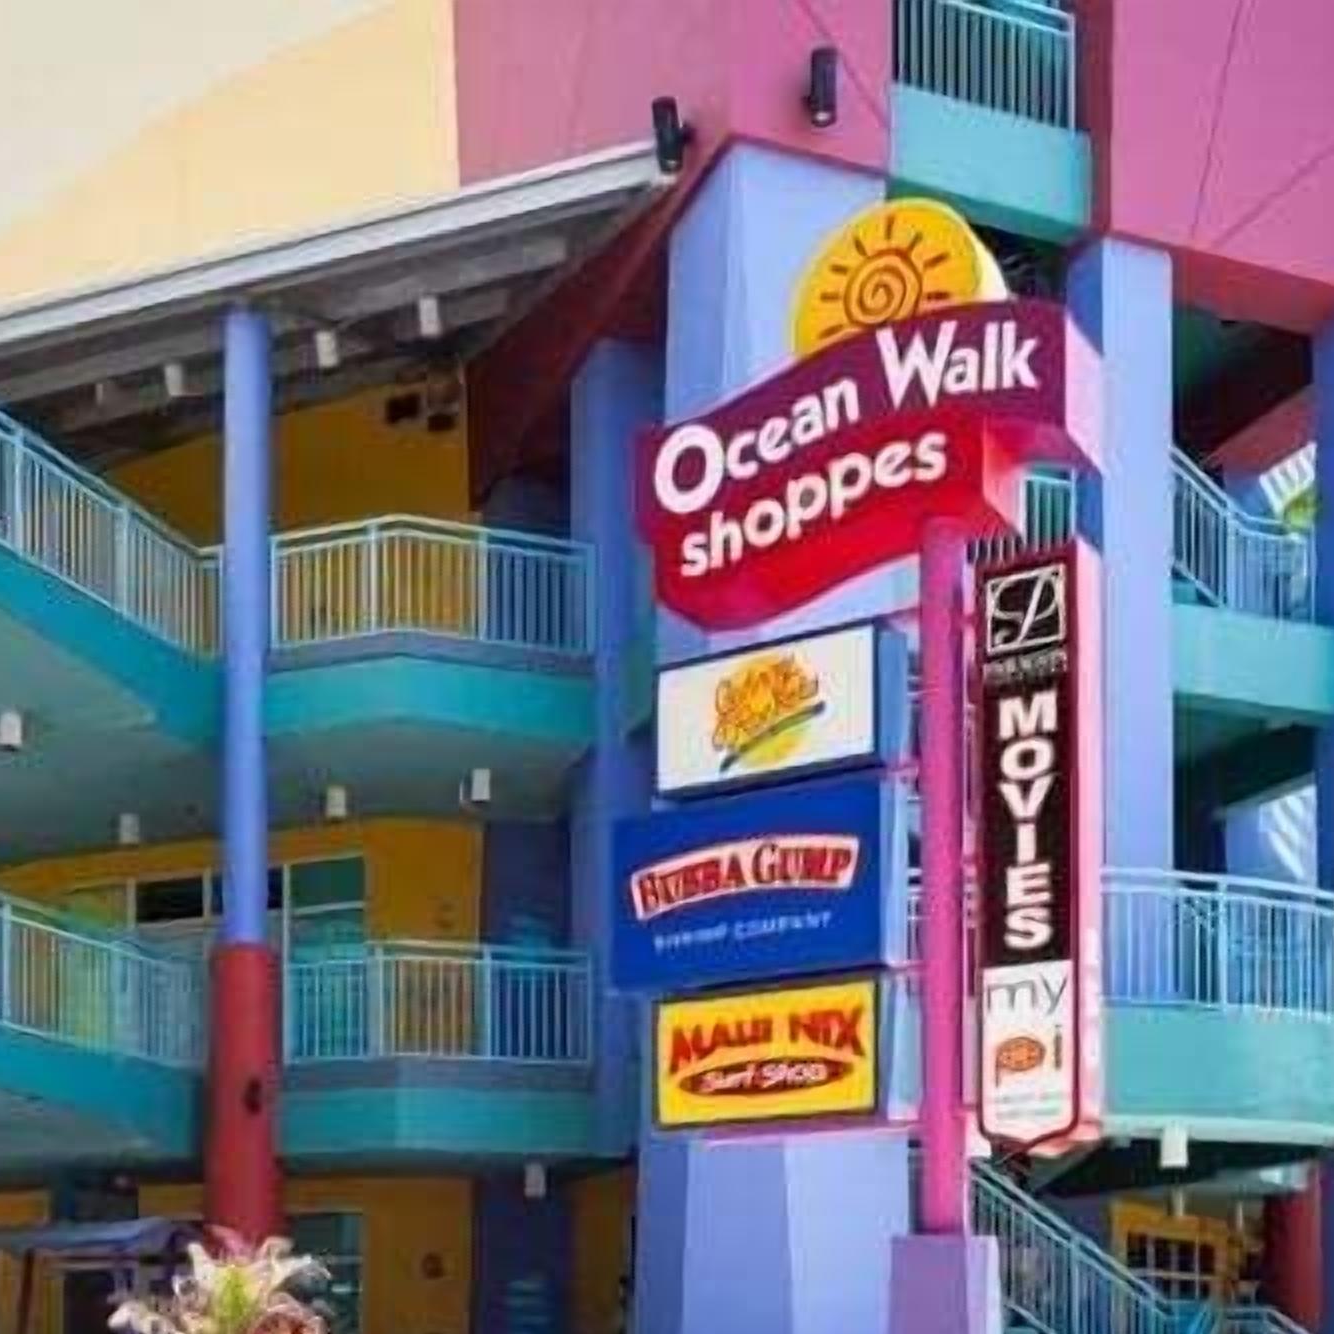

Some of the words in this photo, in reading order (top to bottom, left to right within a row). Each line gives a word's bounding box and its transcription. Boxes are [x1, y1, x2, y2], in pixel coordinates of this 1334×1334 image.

[654, 377, 860, 513] Ocean
[875, 320, 1038, 407] Walk
[680, 431, 948, 576] shoppes
[996, 689, 1058, 951] MOVIES
[639, 853, 747, 913] BUBBA
[751, 843, 853, 885] GUMP
[669, 1014, 773, 1075] MAUI
[788, 1005, 865, 1057] NIX
[986, 972, 1068, 1015] my
